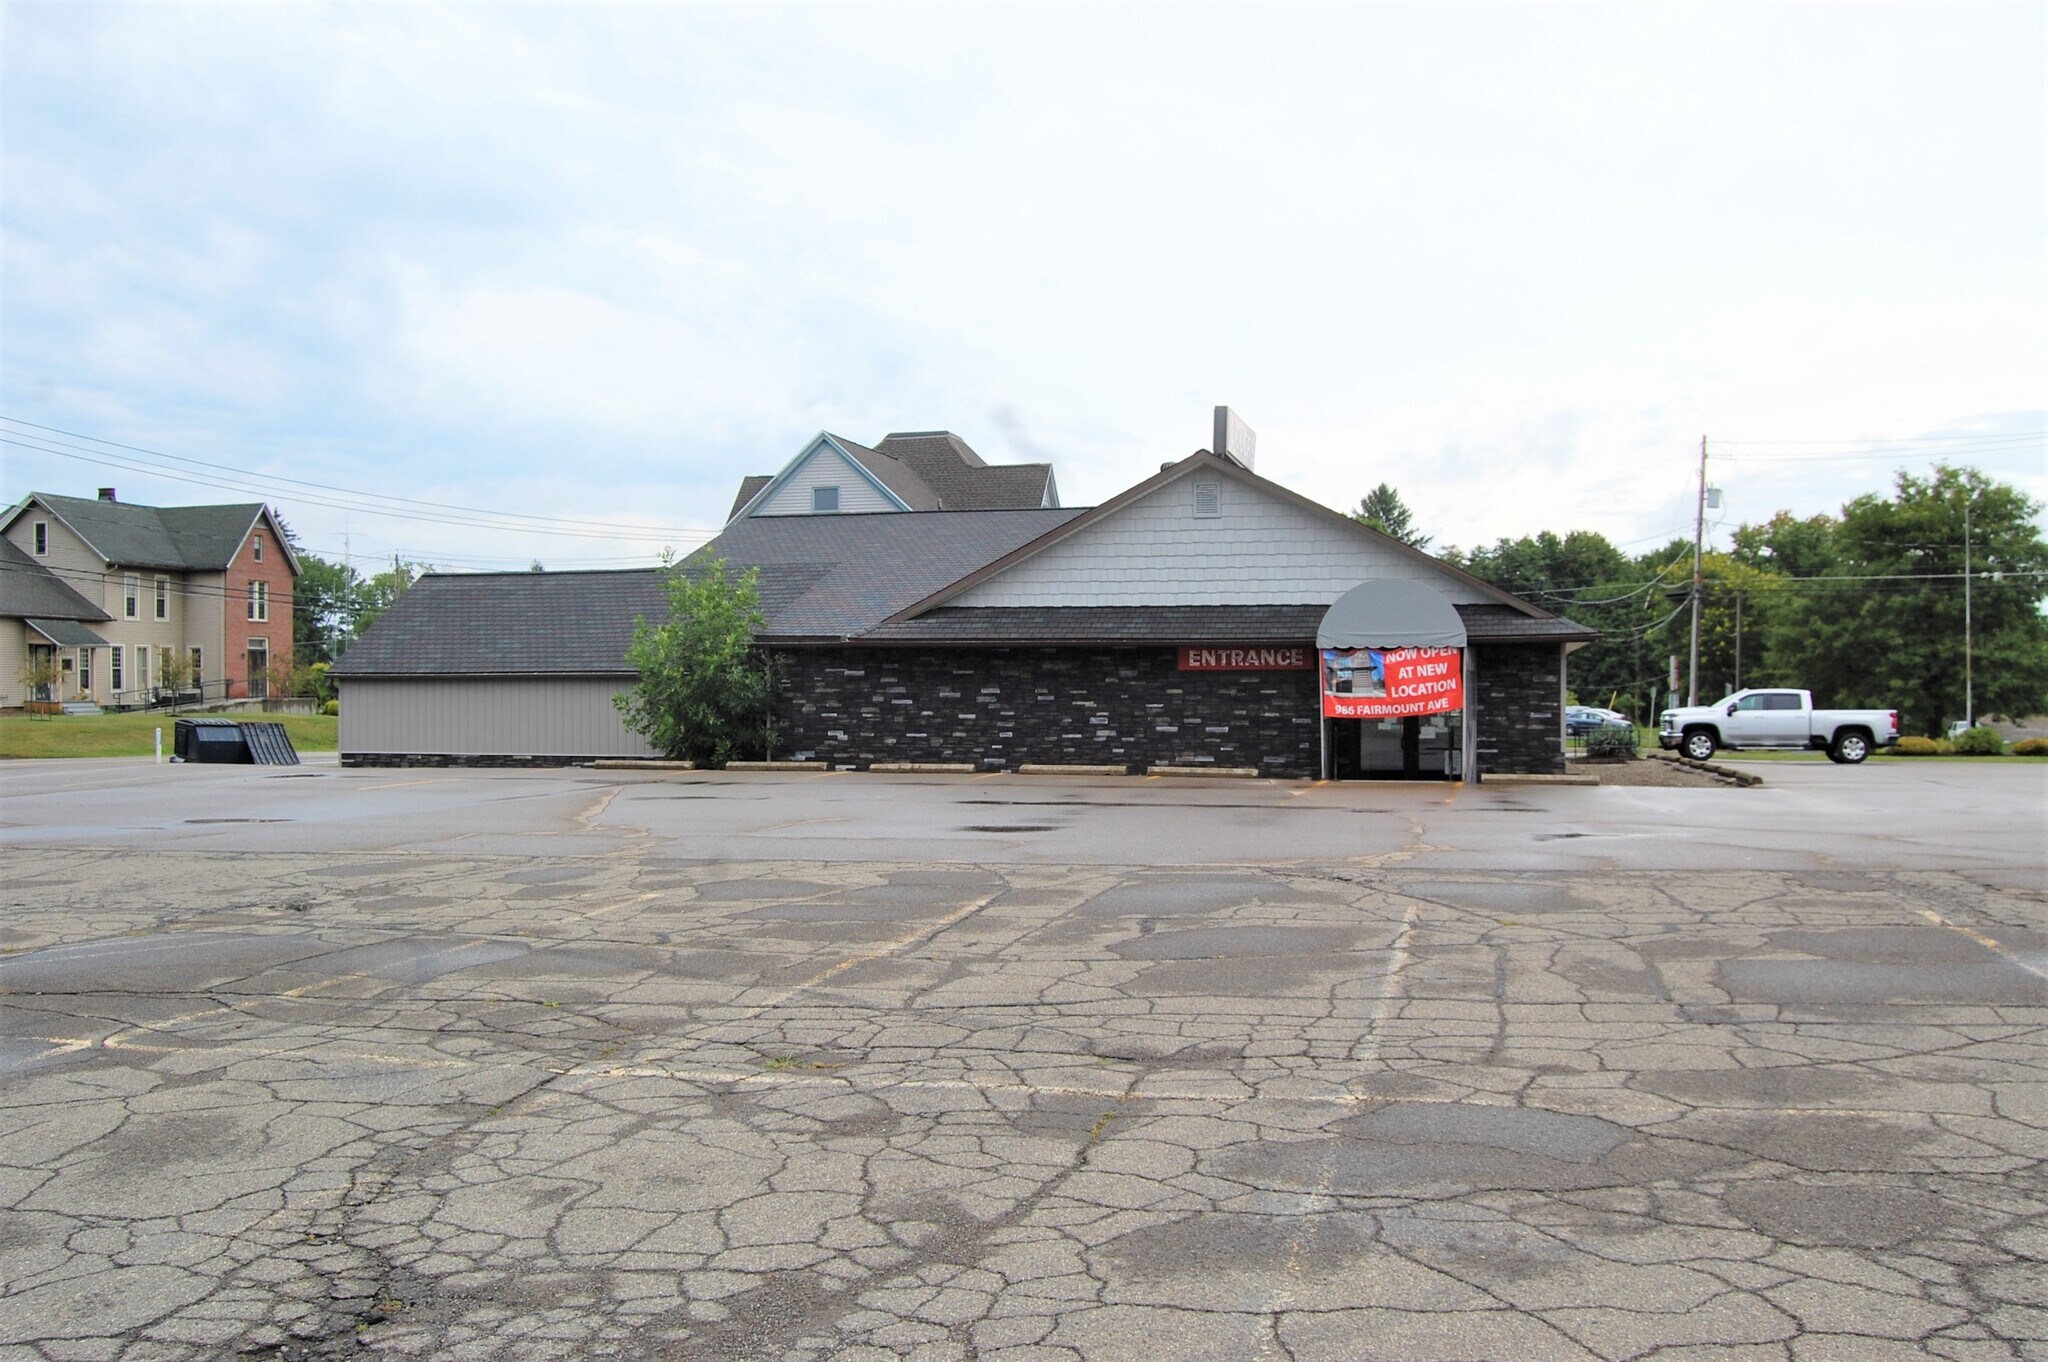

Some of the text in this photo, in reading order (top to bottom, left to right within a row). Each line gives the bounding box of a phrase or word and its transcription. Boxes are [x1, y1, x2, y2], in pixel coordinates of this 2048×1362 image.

[1189, 649, 1303, 666] ENTRANCE
[1386, 647, 1458, 663] NOW OPEN
[1398, 662, 1448, 679] AT NEW
[1391, 678, 1457, 698] LOCATION
[1335, 698, 1449, 715] 986 FAIRMOUNT AVE
